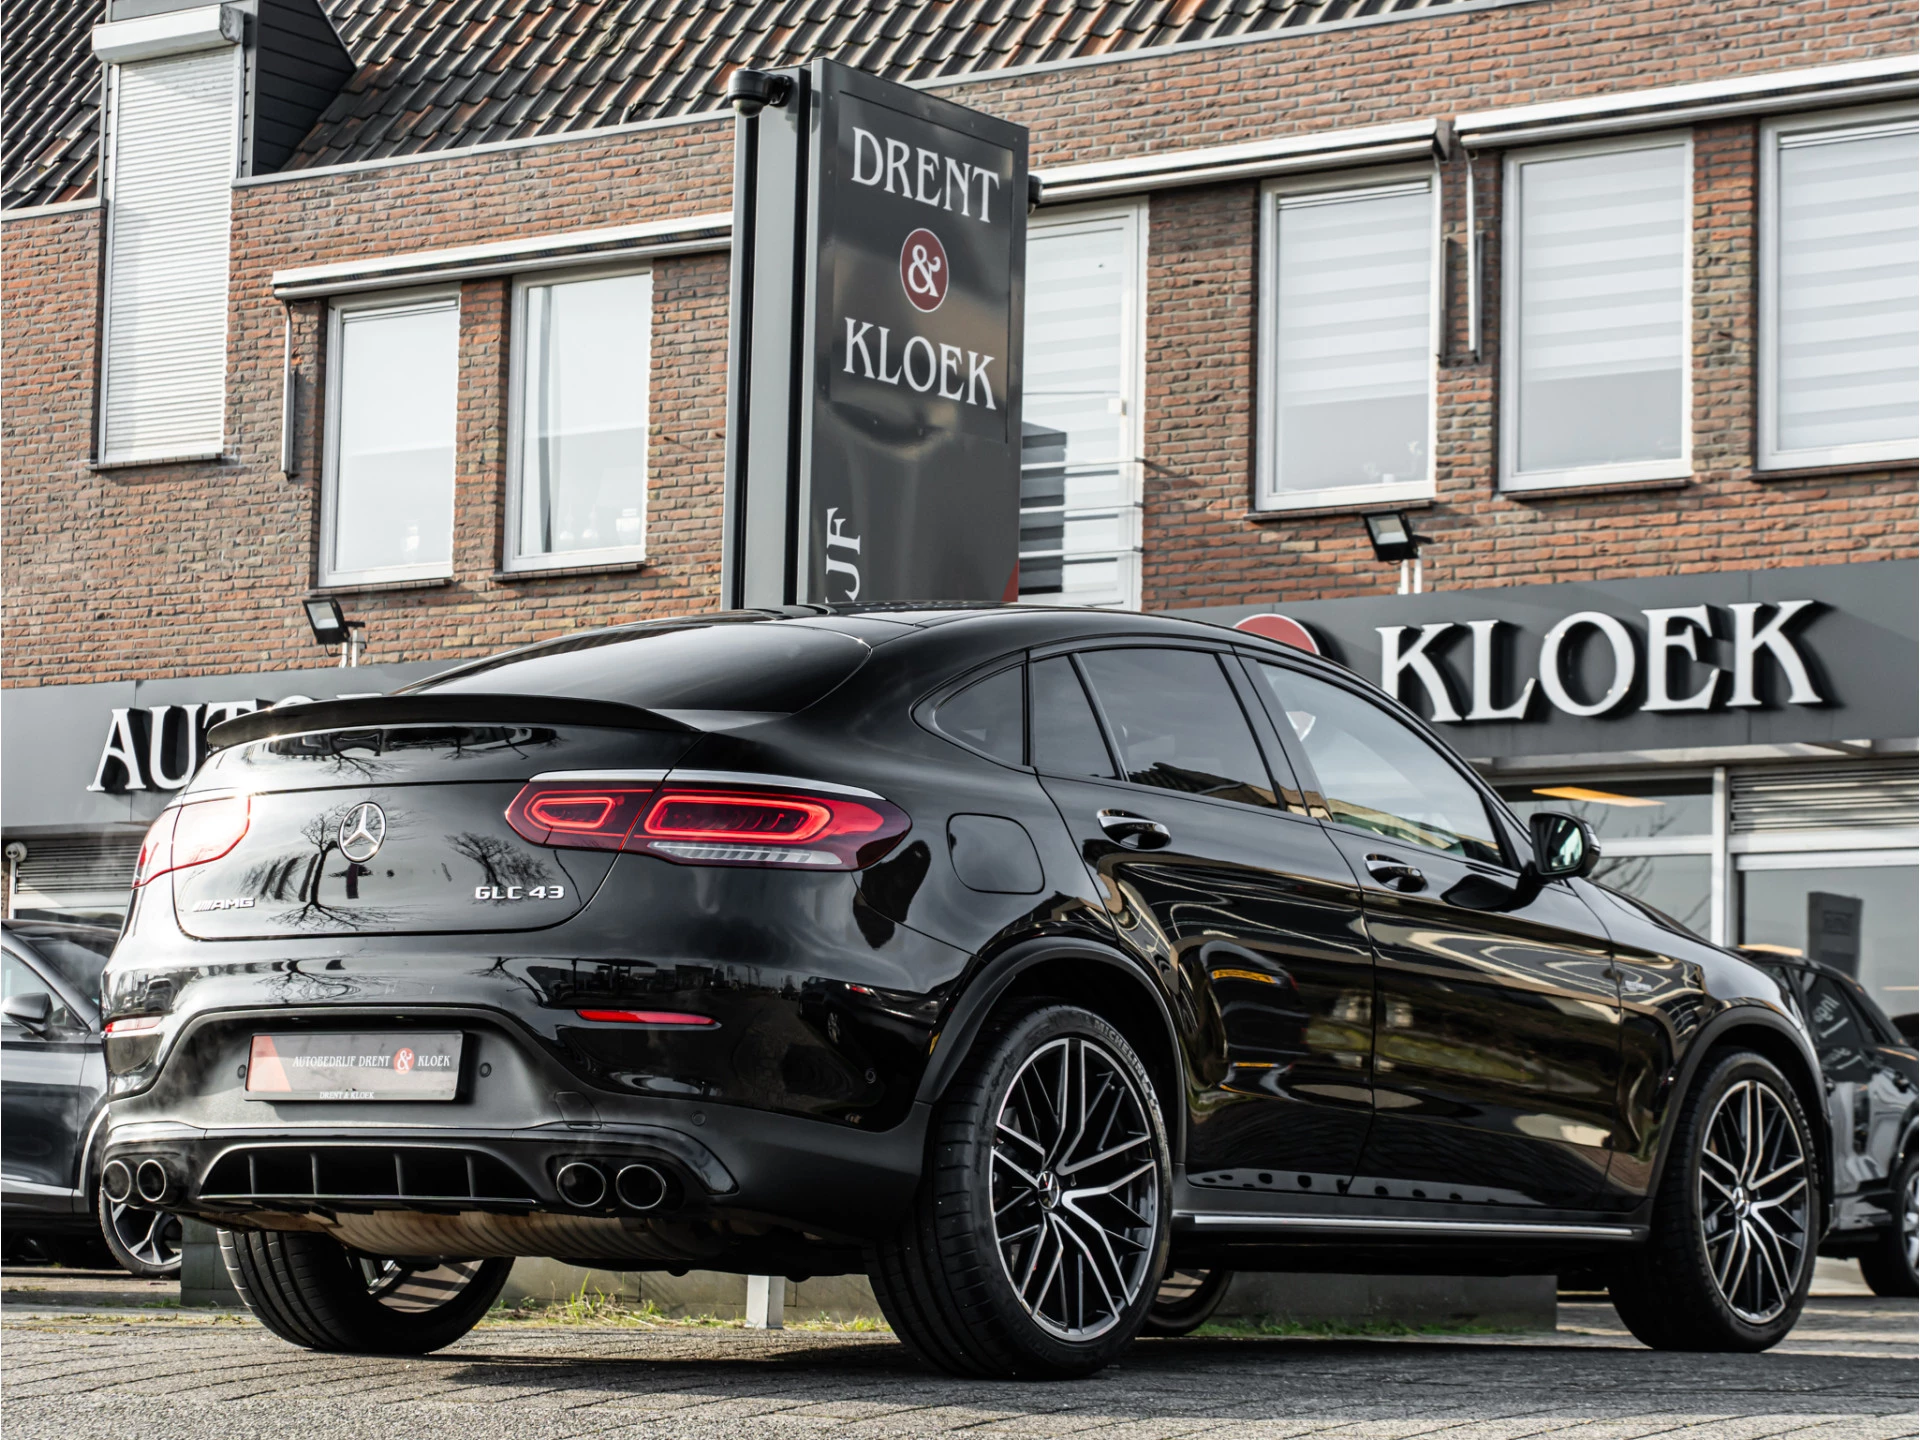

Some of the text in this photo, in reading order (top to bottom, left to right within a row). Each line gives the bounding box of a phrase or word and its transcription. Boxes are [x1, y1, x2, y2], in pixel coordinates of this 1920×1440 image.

[851, 126, 1000, 223] DRENT
[907, 243, 941, 298] &
[843, 317, 997, 410] KLOEK
[1375, 600, 1823, 723] KLOEK
[474, 884, 565, 900] GLC 43
[292, 1050, 450, 1070] AUTOBEDRIJF DRENT & KLOEK
[1094, 1018, 1145, 1077] MICHELIN
[319, 1091, 343, 1099] DRENT
[350, 1091, 374, 1099] KLOEK
